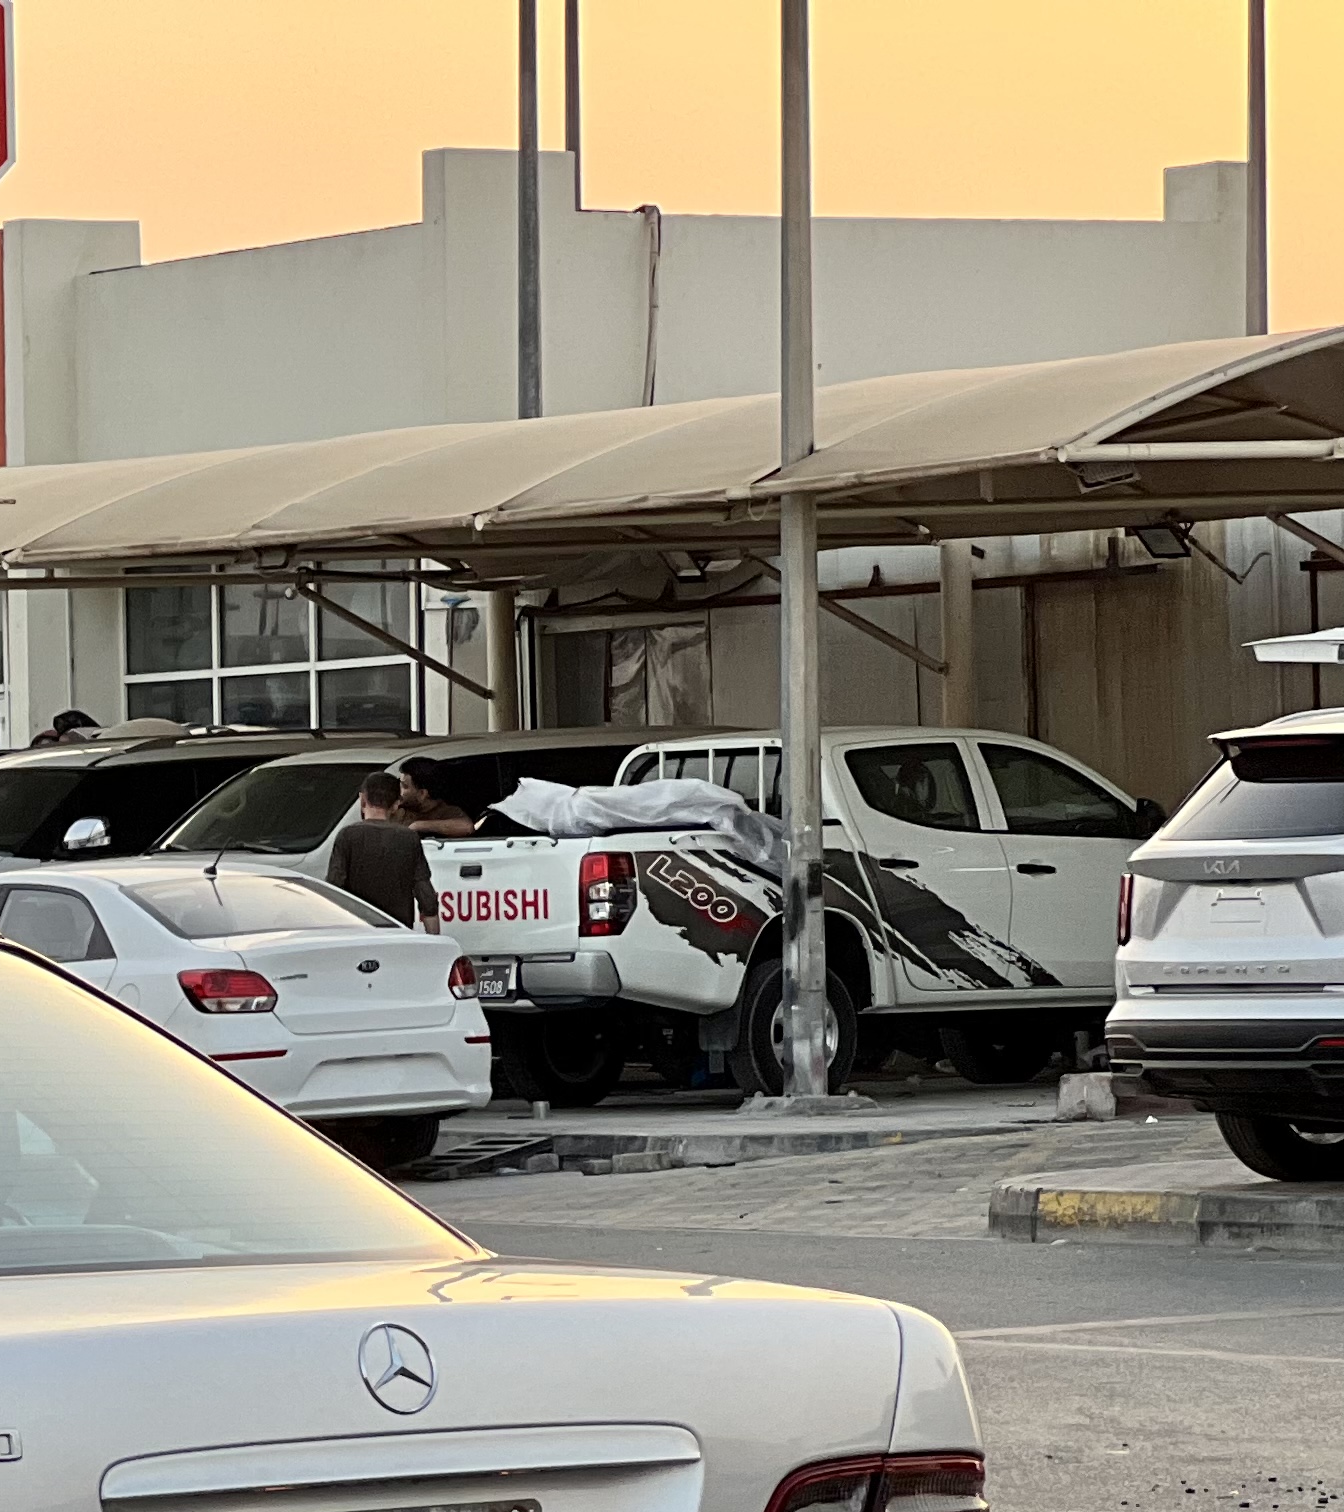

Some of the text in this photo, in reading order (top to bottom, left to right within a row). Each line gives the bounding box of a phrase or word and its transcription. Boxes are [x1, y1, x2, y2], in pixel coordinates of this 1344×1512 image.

[1203, 860, 1240, 874] KIA
[646, 854, 737, 923] L200
[440, 889, 549, 922] SUBISHI
